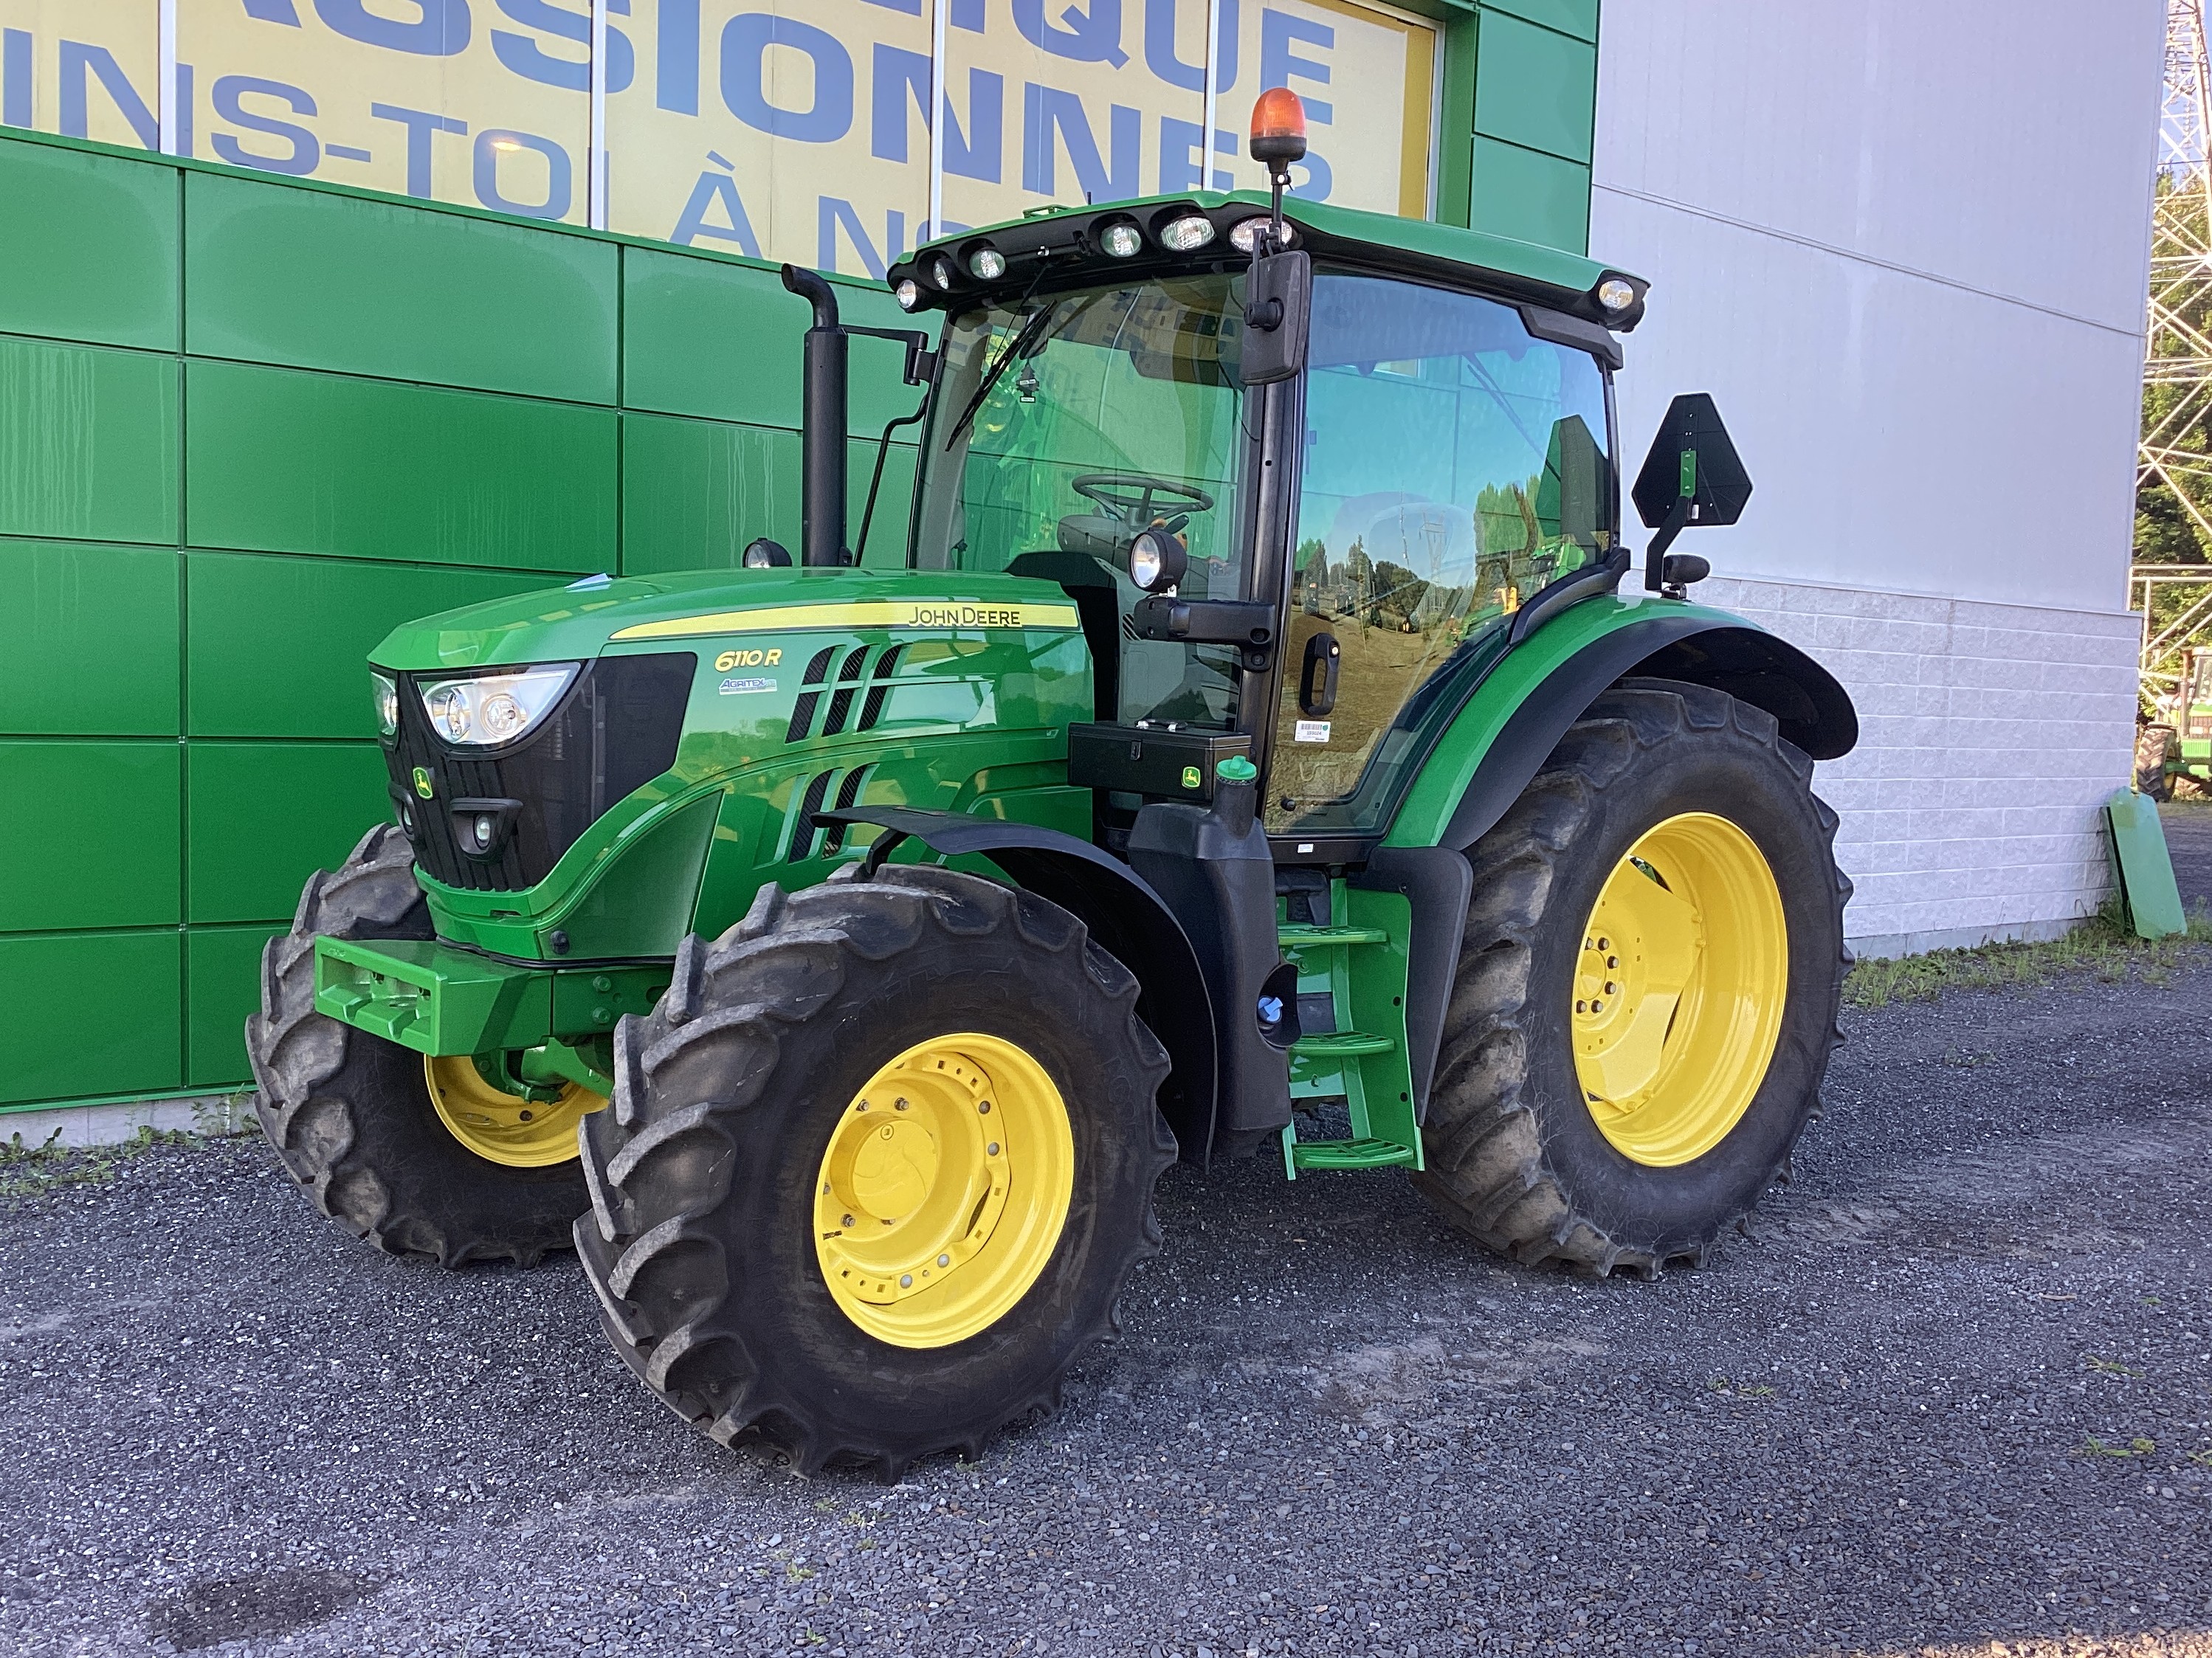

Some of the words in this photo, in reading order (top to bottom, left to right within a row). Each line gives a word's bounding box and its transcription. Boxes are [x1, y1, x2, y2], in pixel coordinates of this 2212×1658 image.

[3, 27, 609, 230] INS-TO
[669, 150, 763, 260] À
[908, 606, 959, 625] JOHN
[962, 606, 1021, 626] DEERE
